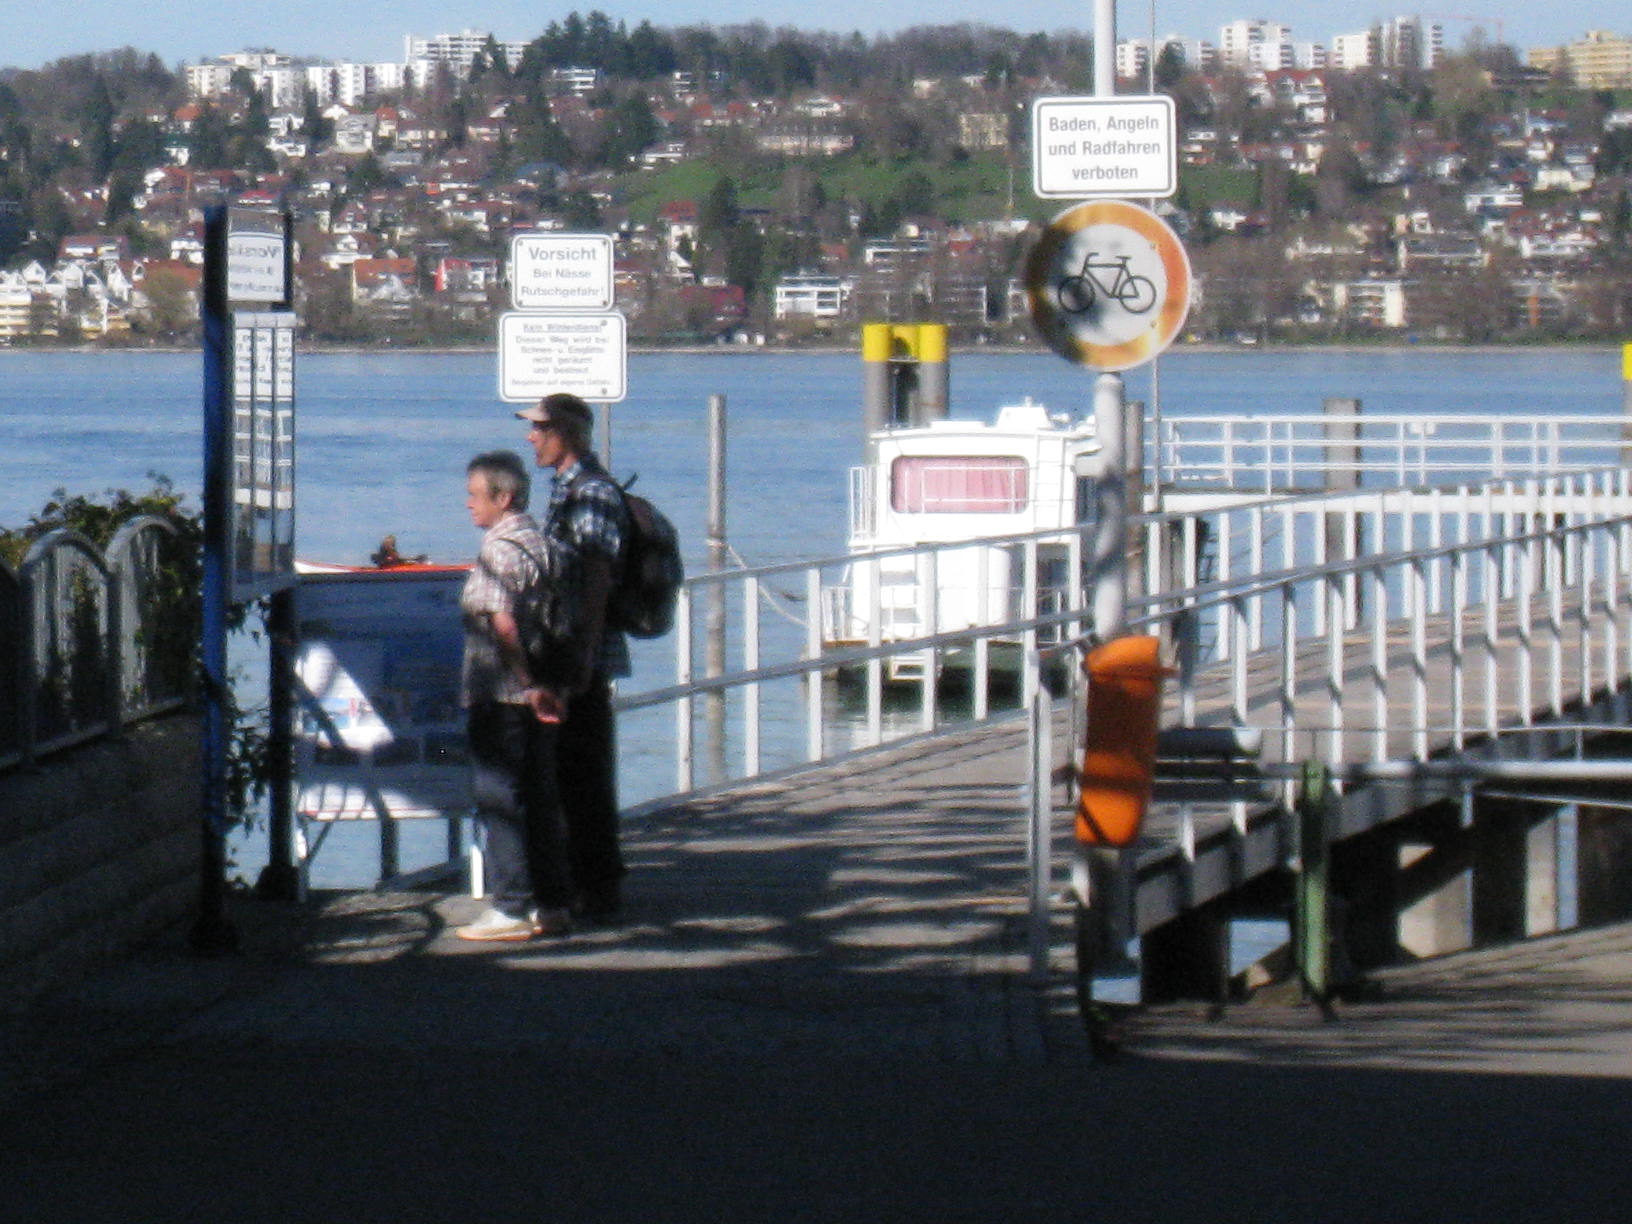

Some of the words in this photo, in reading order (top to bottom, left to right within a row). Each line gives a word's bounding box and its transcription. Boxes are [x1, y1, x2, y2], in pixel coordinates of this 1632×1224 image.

[1049, 117, 1100, 133] Baden,
[1106, 115, 1159, 133] Angeln
[1048, 140, 1076, 155] und
[1082, 140, 1161, 155] Radfahren
[1071, 165, 1138, 180] verboten
[528, 247, 596, 261] Vorsicht
[533, 268, 552, 278] Bei
[555, 267, 591, 278] Nässe
[521, 286, 604, 298] Rutschgefahr!
